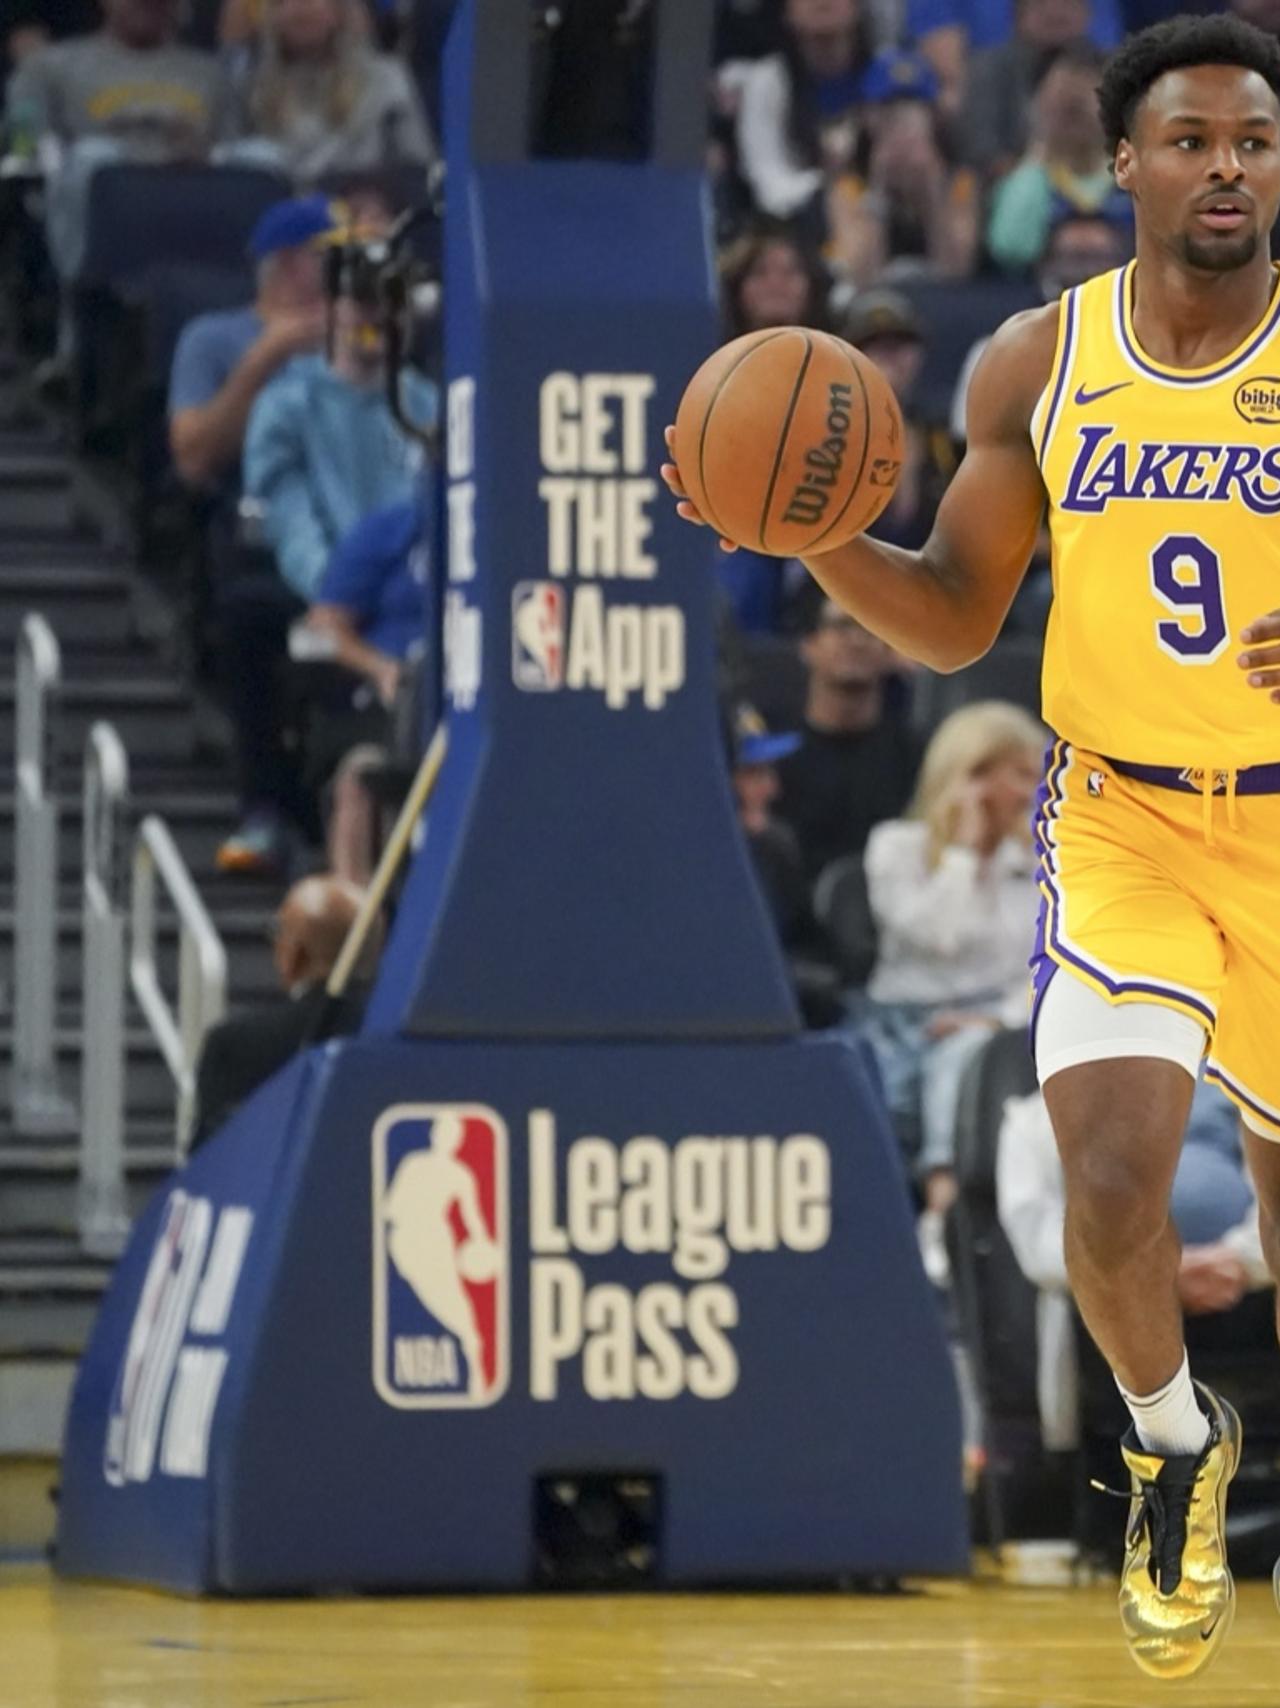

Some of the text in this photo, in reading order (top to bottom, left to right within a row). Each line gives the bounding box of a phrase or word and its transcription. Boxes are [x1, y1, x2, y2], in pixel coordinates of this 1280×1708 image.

[539, 372, 656, 474] GET
[782, 383, 852, 526] Wilson
[538, 477, 657, 578] THE
[566, 583, 686, 711] App
[1151, 534, 1229, 664] 9
[528, 1108, 830, 1280] League
[394, 1336, 457, 1386] NBA
[529, 1257, 739, 1401] Pass
